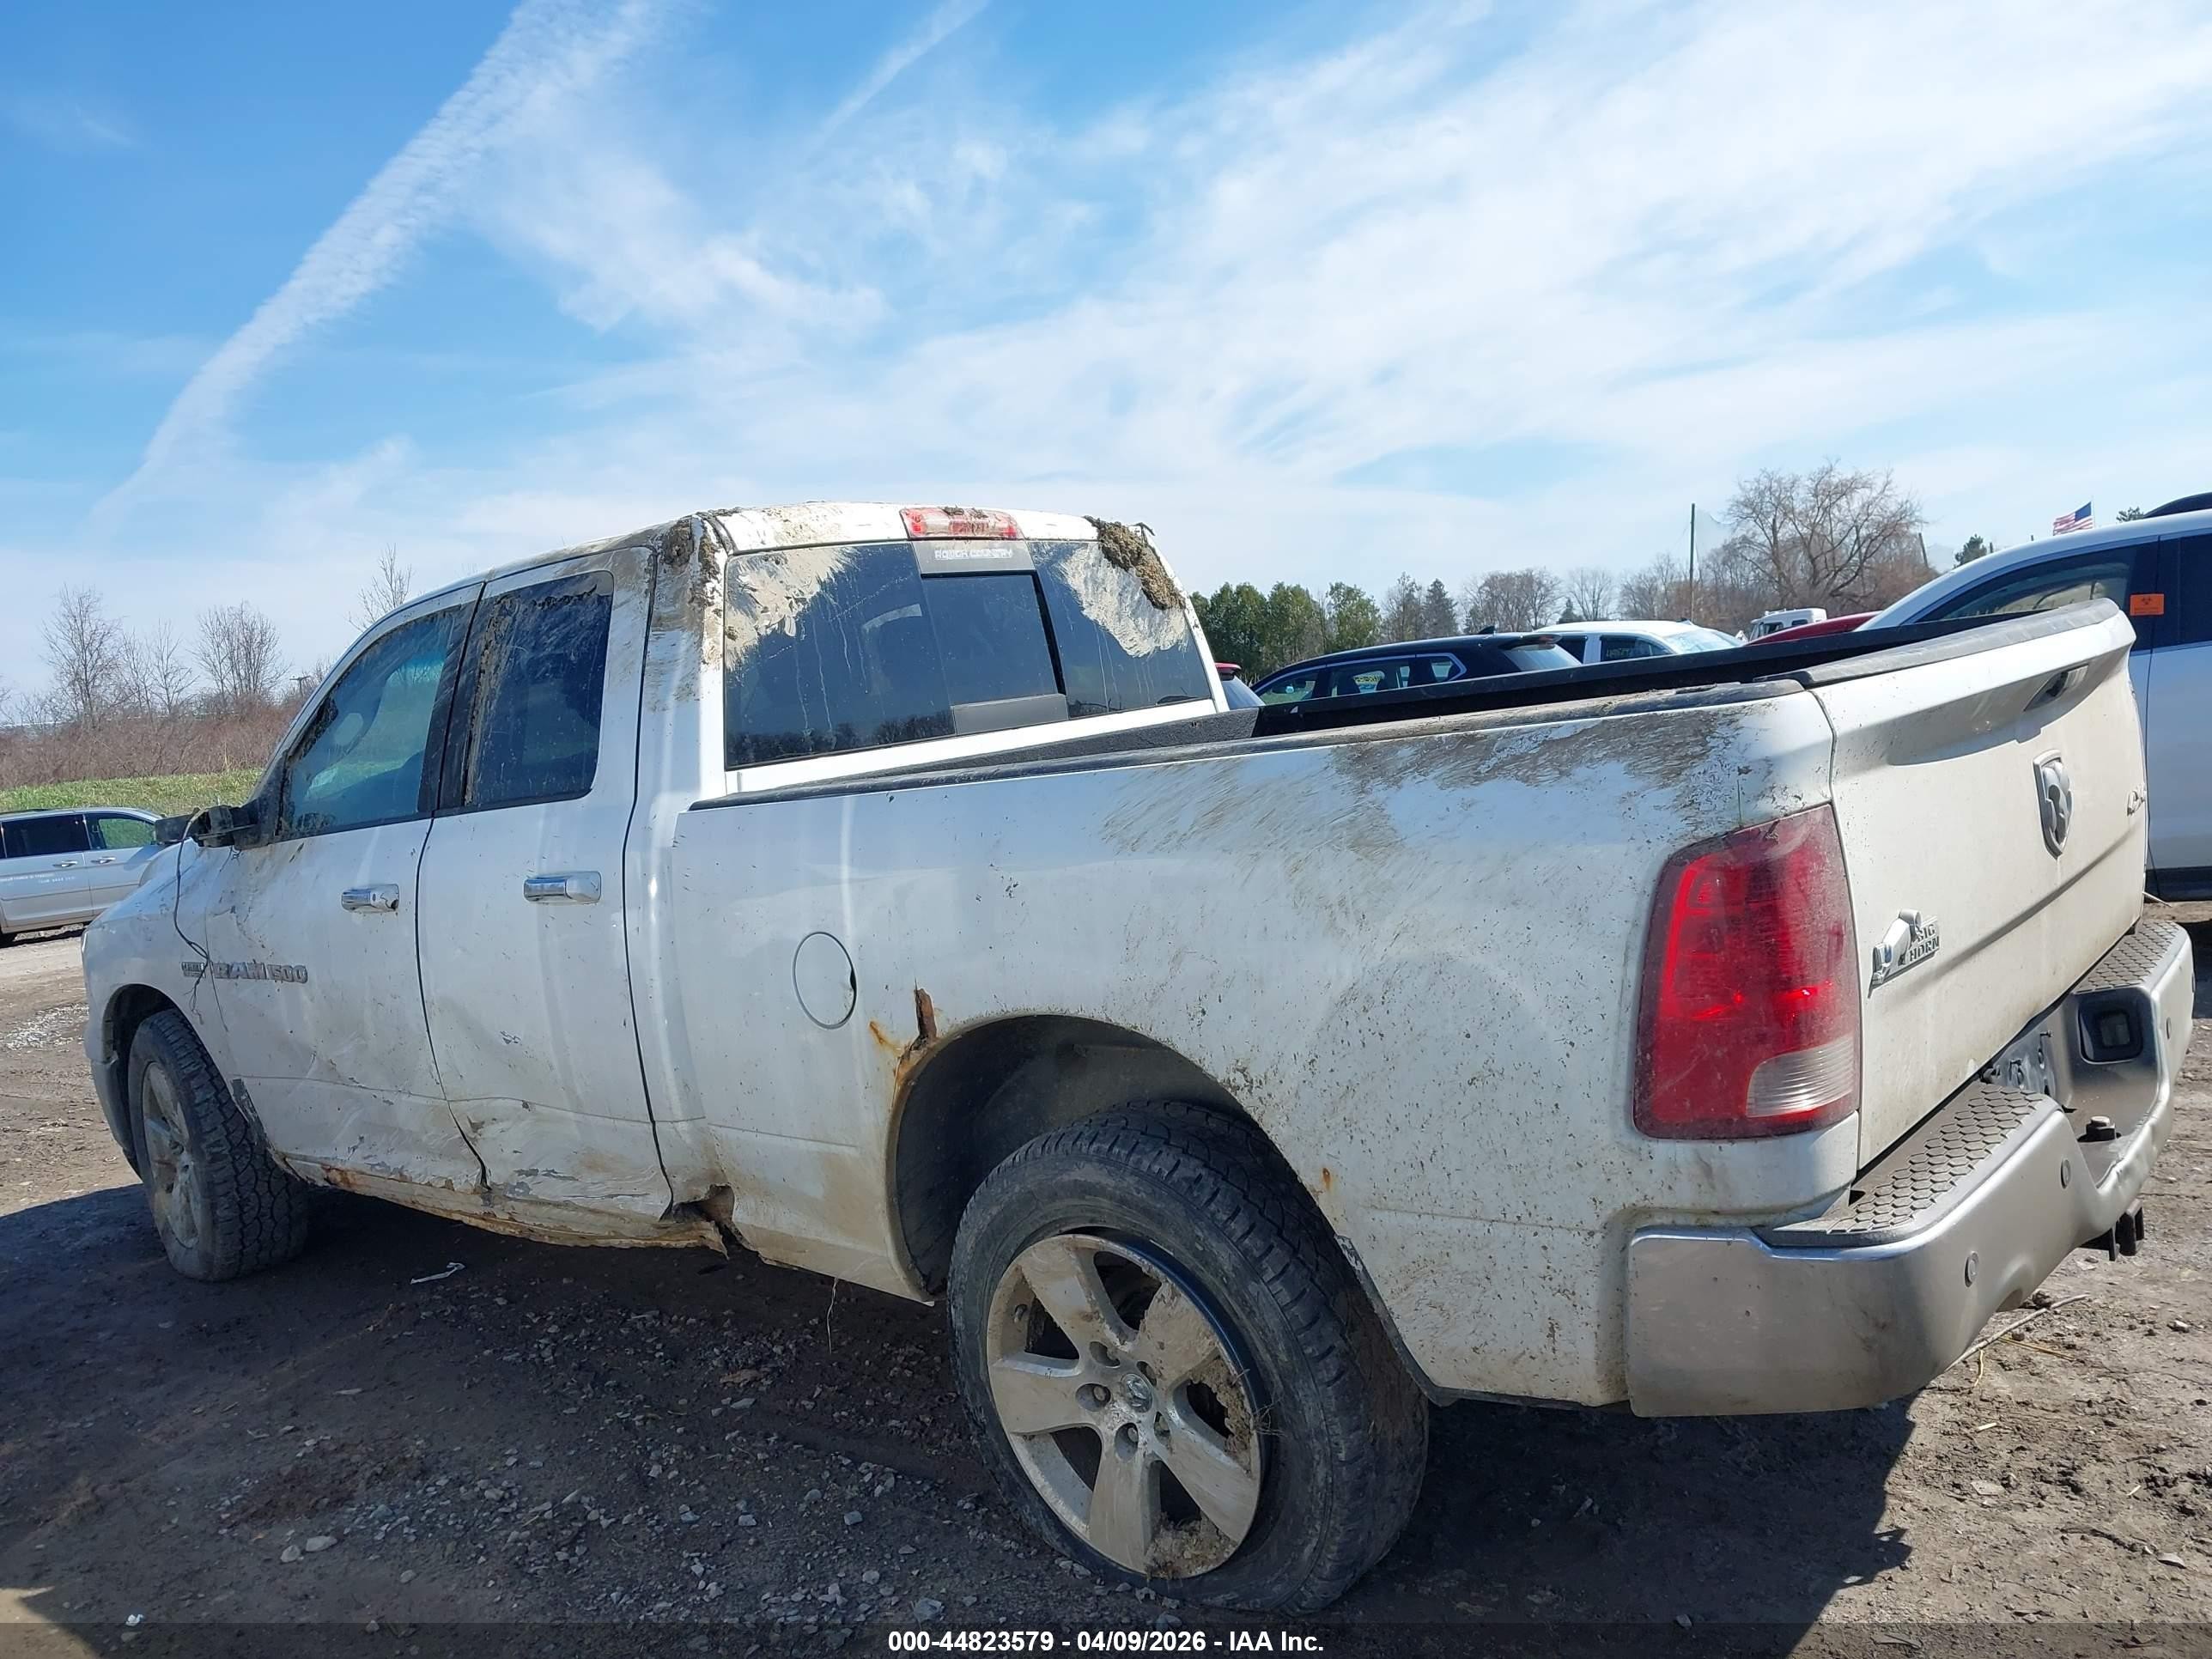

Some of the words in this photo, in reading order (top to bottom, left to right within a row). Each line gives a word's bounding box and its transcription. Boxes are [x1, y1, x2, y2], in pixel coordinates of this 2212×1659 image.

[1909, 936, 1940, 962] HORN
[213, 961, 267, 980] RAM
[267, 963, 308, 983] 1500
